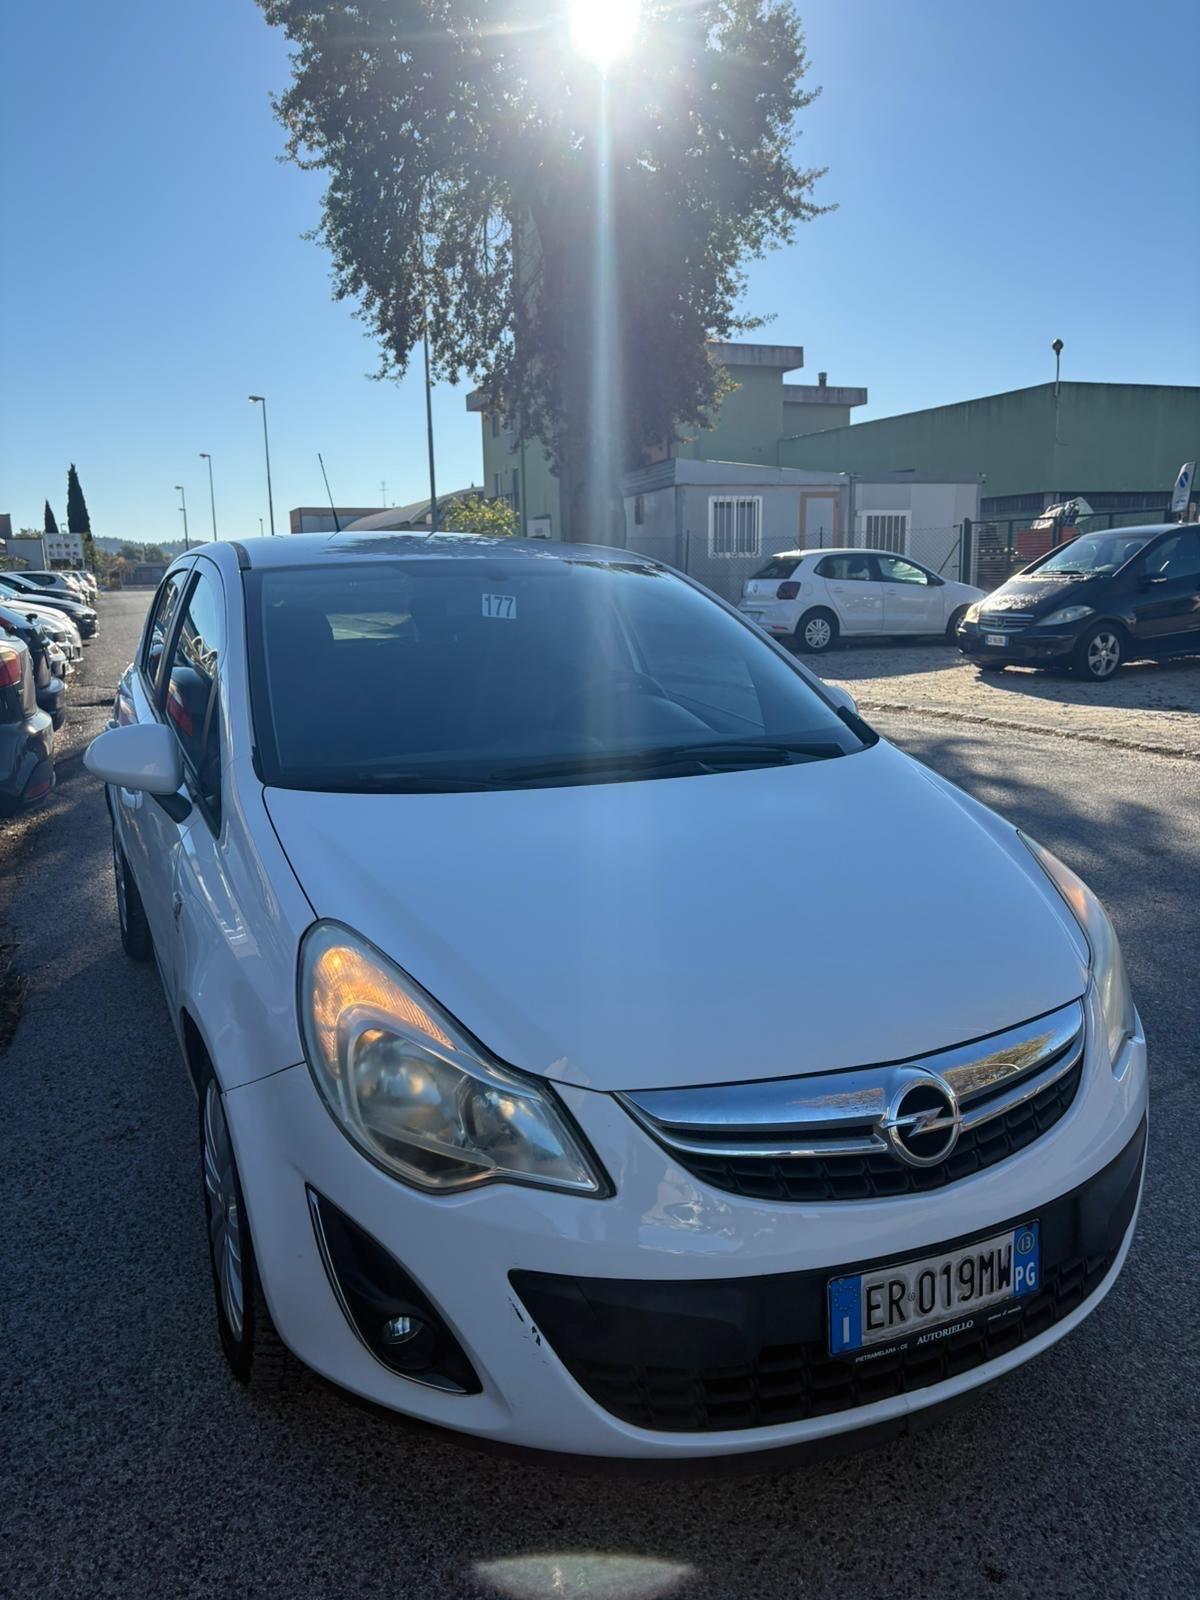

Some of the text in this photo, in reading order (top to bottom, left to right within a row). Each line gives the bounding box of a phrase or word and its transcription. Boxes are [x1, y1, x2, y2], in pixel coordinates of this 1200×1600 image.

[484, 595, 514, 617] 177
[1019, 1236, 1033, 1251] 13
[1015, 1262, 1036, 1291] PG
[917, 1320, 974, 1345] AUTORIELLO
